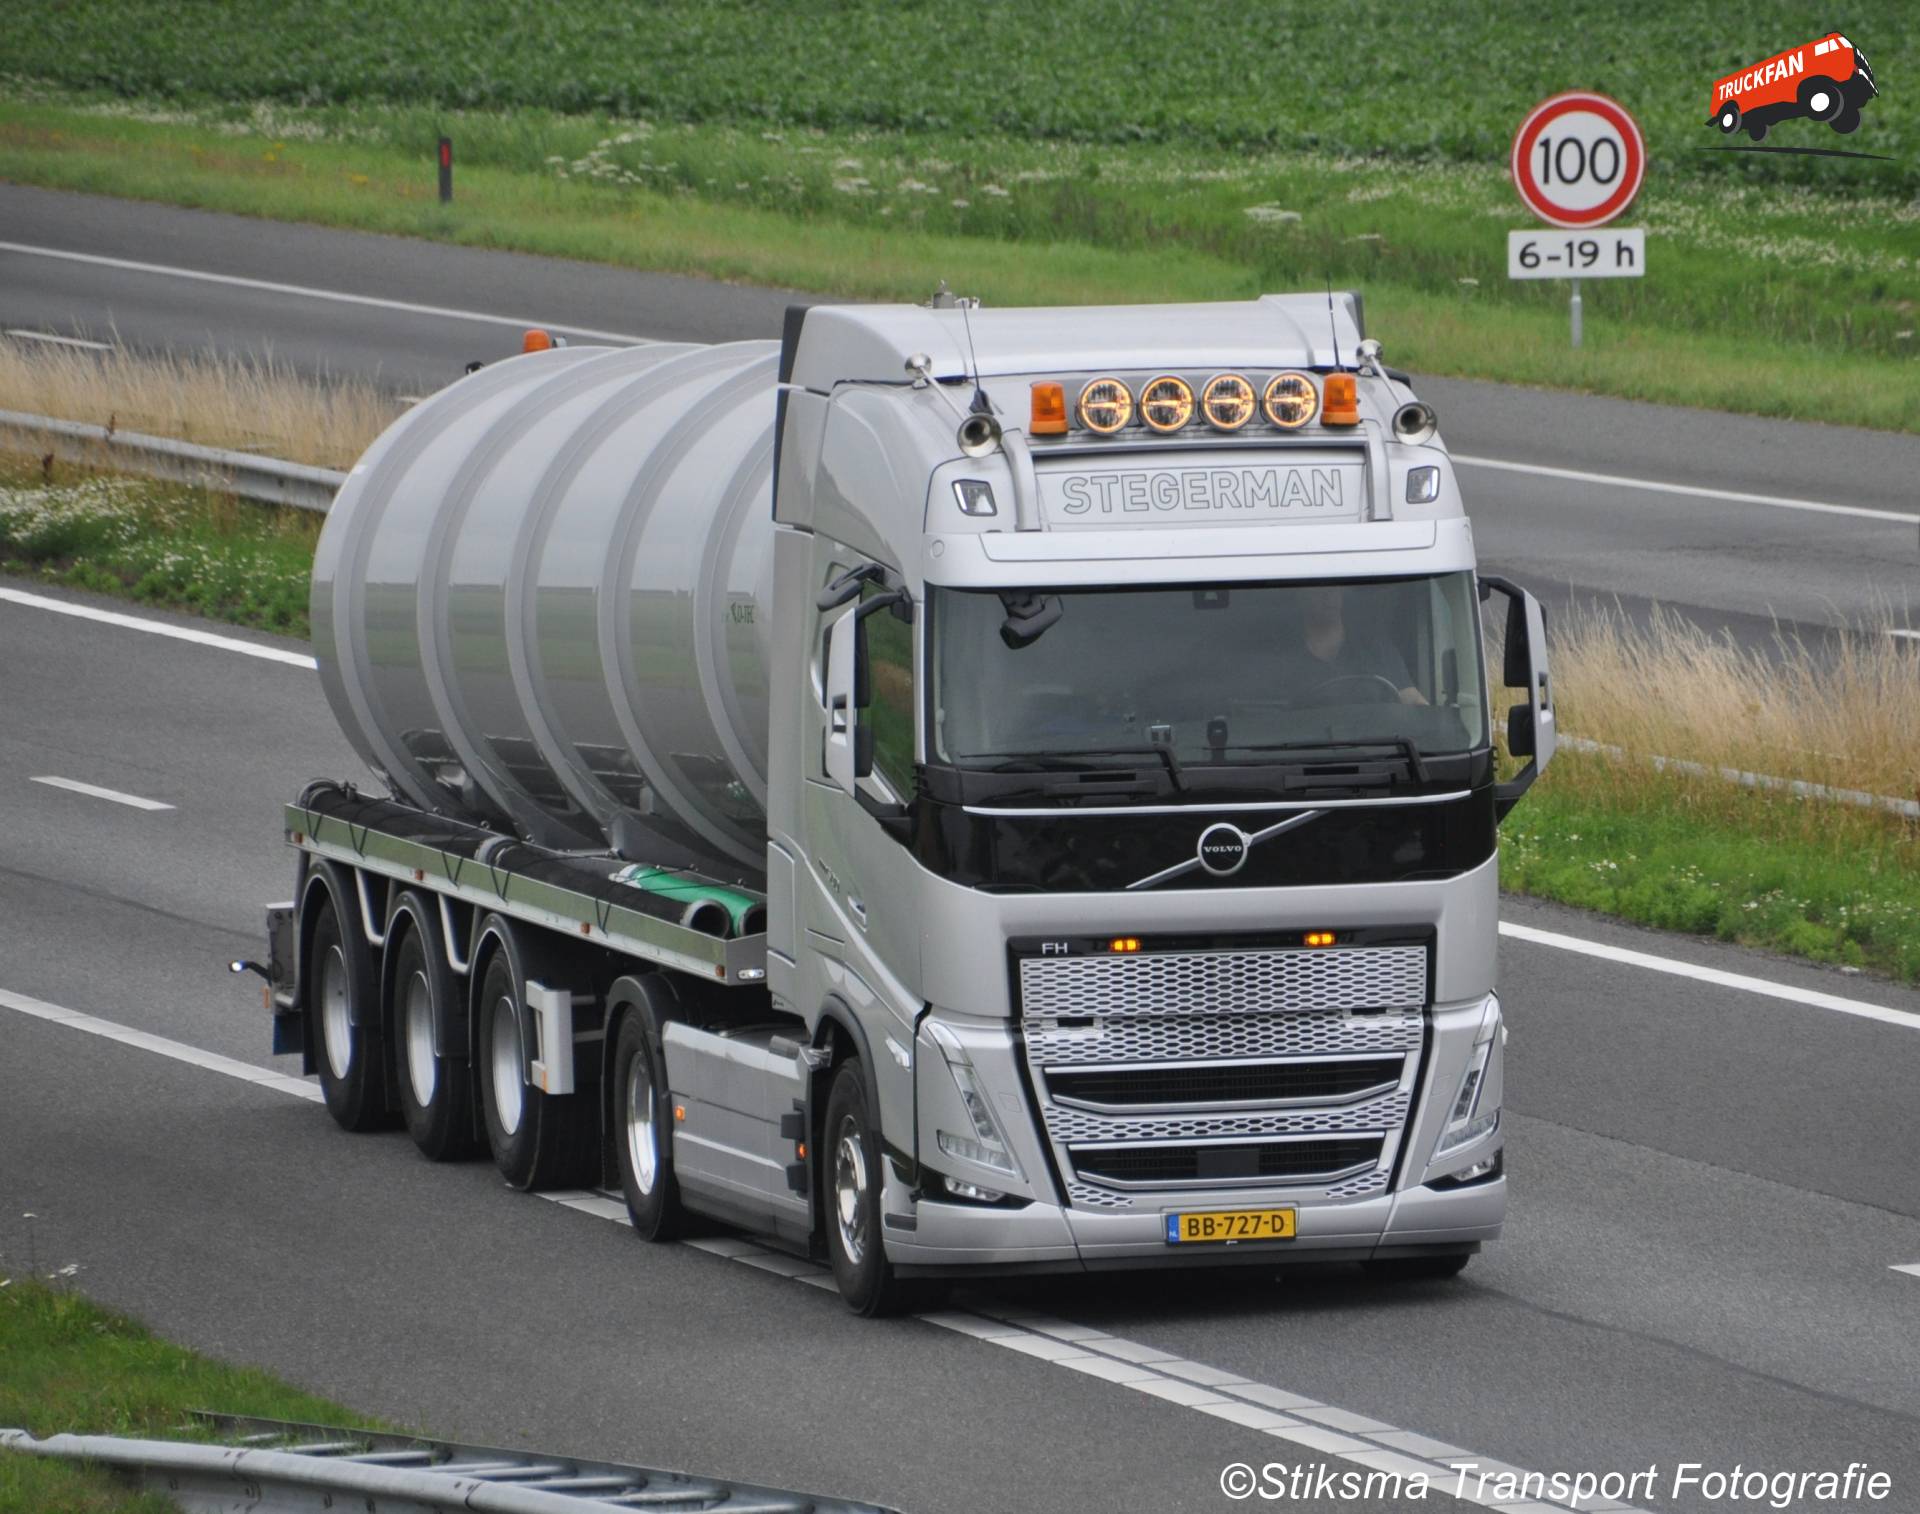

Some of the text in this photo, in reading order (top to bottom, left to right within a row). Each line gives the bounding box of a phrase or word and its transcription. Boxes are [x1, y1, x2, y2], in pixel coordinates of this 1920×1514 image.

[1538, 137, 1620, 185] 100
[1519, 238, 1635, 269] 6-19 h
[1062, 469, 1343, 514] STEGERMAN
[1203, 845, 1242, 853] VOLVO
[1042, 942, 1068, 955] FH
[1187, 1214, 1285, 1237] BB-727-D
